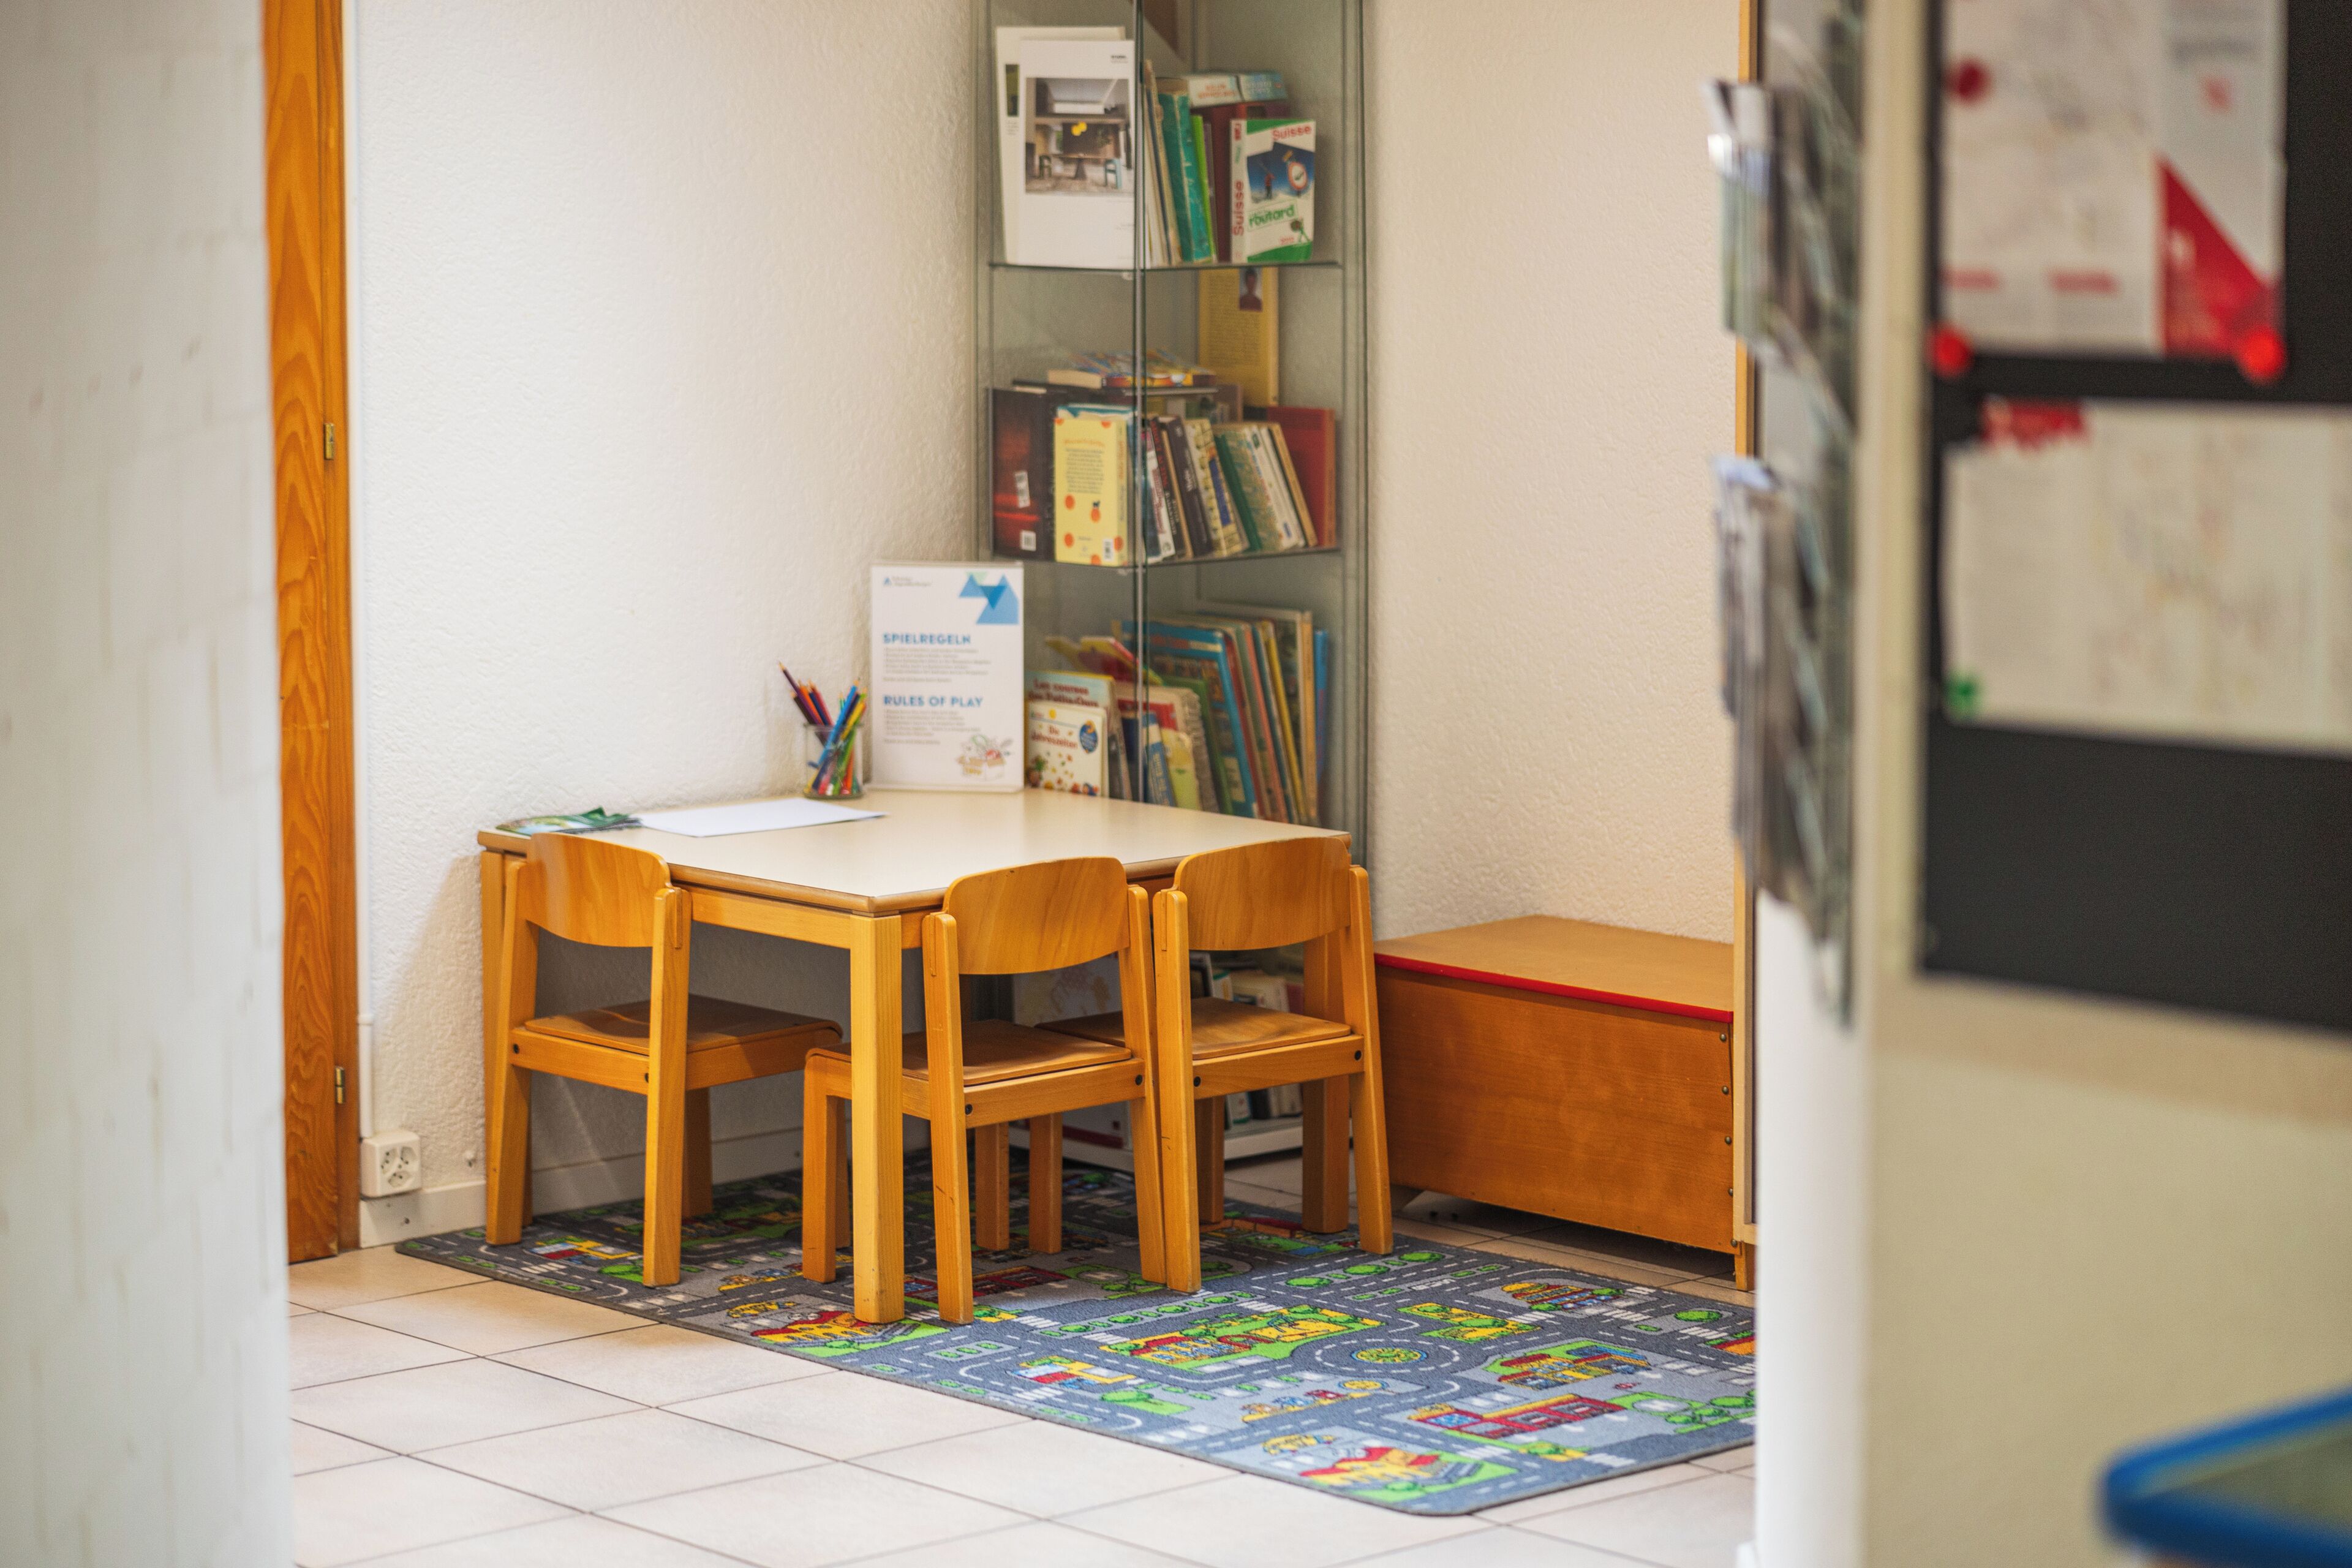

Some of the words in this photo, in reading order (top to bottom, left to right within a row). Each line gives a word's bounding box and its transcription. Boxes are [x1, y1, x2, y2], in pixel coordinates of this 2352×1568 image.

[1272, 126, 1311, 140] Suisse
[1232, 181, 1245, 236] Suisse
[1249, 204, 1295, 227] routard
[883, 633, 971, 644] SPIELREGELN
[883, 695, 924, 706] RULES
[929, 696, 946, 706] OF
[951, 696, 983, 707] PLAY
